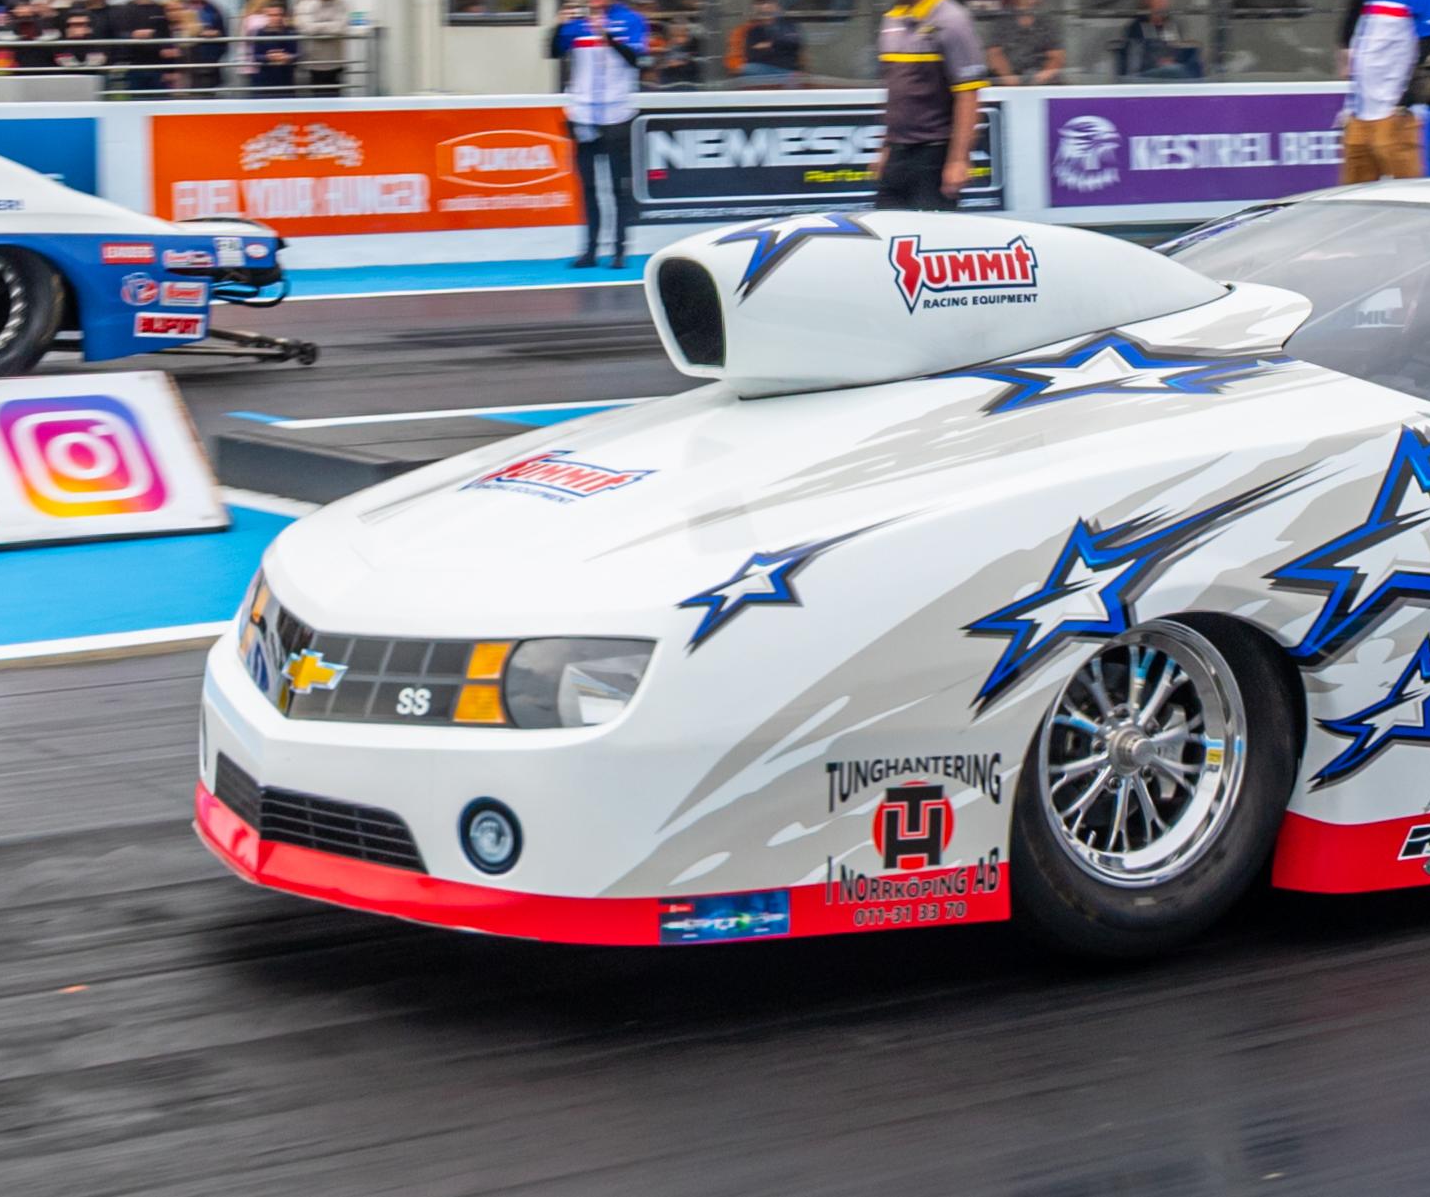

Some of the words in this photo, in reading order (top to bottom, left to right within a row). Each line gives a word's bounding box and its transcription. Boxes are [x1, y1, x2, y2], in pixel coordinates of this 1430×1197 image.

[1128, 132, 1272, 171] KESTREL
[1278, 129, 1346, 165] BEE
[923, 296, 968, 309] RACING
[972, 294, 1038, 305] EQUIPMENT
[396, 688, 432, 716] SS
[826, 752, 1002, 812] TUNGHANTERING
[839, 864, 968, 905] NORRKÖPING
[972, 847, 1001, 893] AB
[854, 906, 912, 926] 011-31
[918, 903, 940, 920] 33
[945, 901, 967, 919] 70
